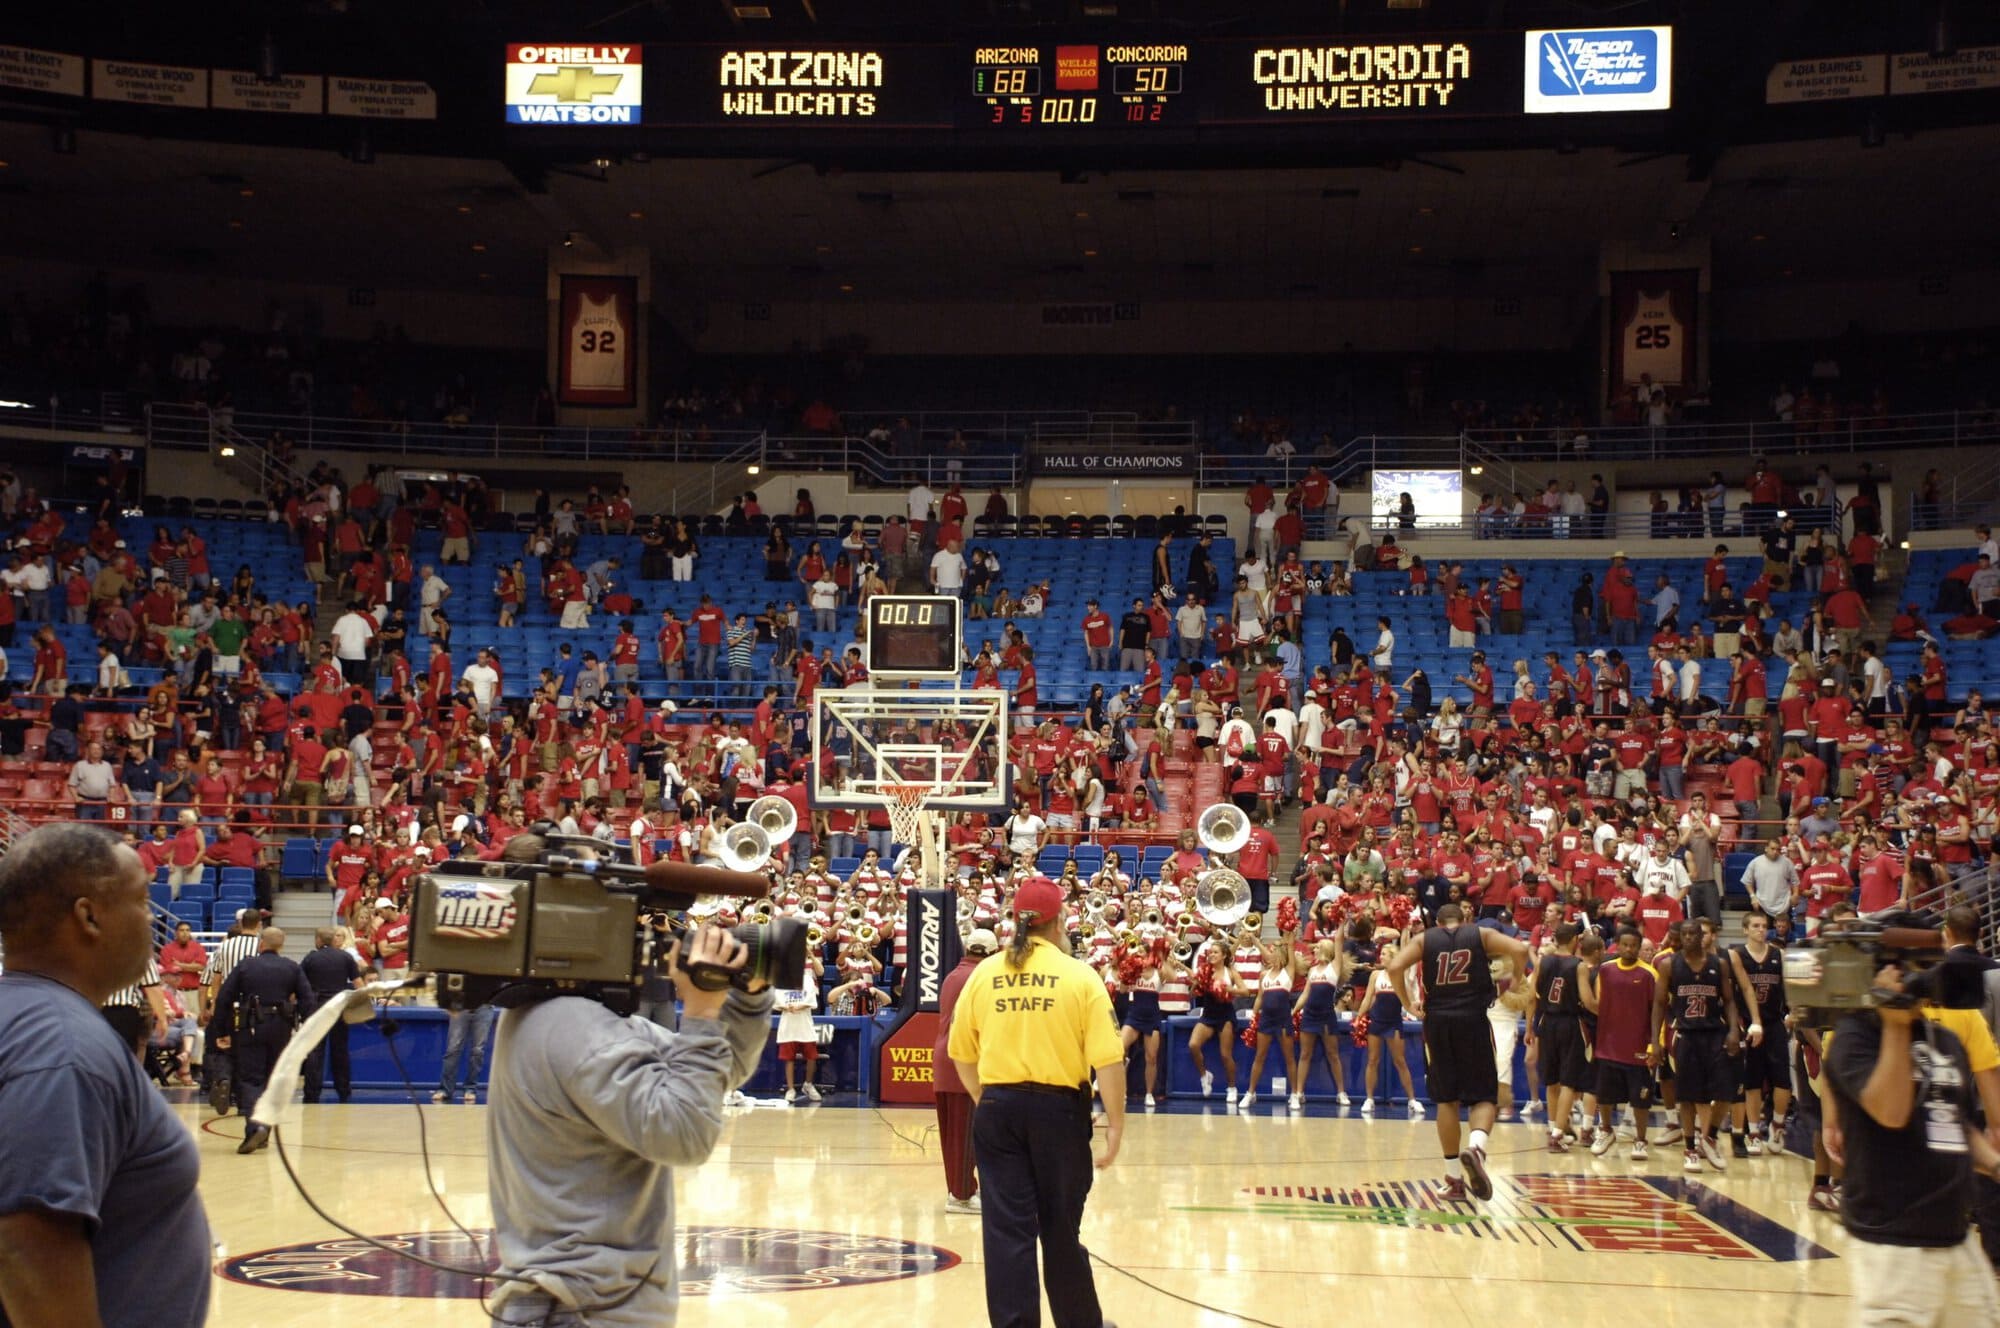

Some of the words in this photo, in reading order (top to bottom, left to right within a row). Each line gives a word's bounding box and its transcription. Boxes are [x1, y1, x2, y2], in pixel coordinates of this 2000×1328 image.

[518, 46, 631, 63] O'RIELLY
[1106, 46, 1188, 62] CONCORDIA
[1567, 38, 1633, 54] Tucson
[975, 48, 1039, 64] ARIZONA
[1057, 59, 1097, 68] WELLS
[1254, 44, 1469, 84] CONCORDIA
[1574, 53, 1647, 70] Electric
[720, 52, 882, 86] ARIZONA
[1059, 68, 1097, 78] FARGO
[1580, 69, 1647, 86] Power
[994, 69, 1026, 93] 68
[1135, 67, 1167, 91] 50
[723, 92, 876, 115] WILDCATS
[1265, 82, 1454, 110] UNIVERSITY
[518, 105, 631, 123] WATSON
[992, 106, 1005, 123] 3
[1020, 106, 1033, 123] 5
[1041, 99, 1096, 123] 00.0
[1127, 104, 1145, 121] 10
[1150, 104, 1163, 121] 2
[581, 330, 616, 353] 32
[1636, 325, 1670, 349] 25
[1044, 456, 1078, 468] HALL
[1082, 456, 1100, 468] OF
[1104, 456, 1183, 468] CHAMPIONS
[878, 604, 932, 625] 00.0
[111, 806, 126, 820] 19
[920, 897, 940, 1006] ARIZONA
[1435, 948, 1472, 986] 12
[992, 972, 1060, 990] EVENT
[1548, 976, 1564, 1004] 6
[994, 996, 1056, 1013] STAFF
[1684, 996, 1706, 1018] 21
[891, 1066, 935, 1083] FAR
